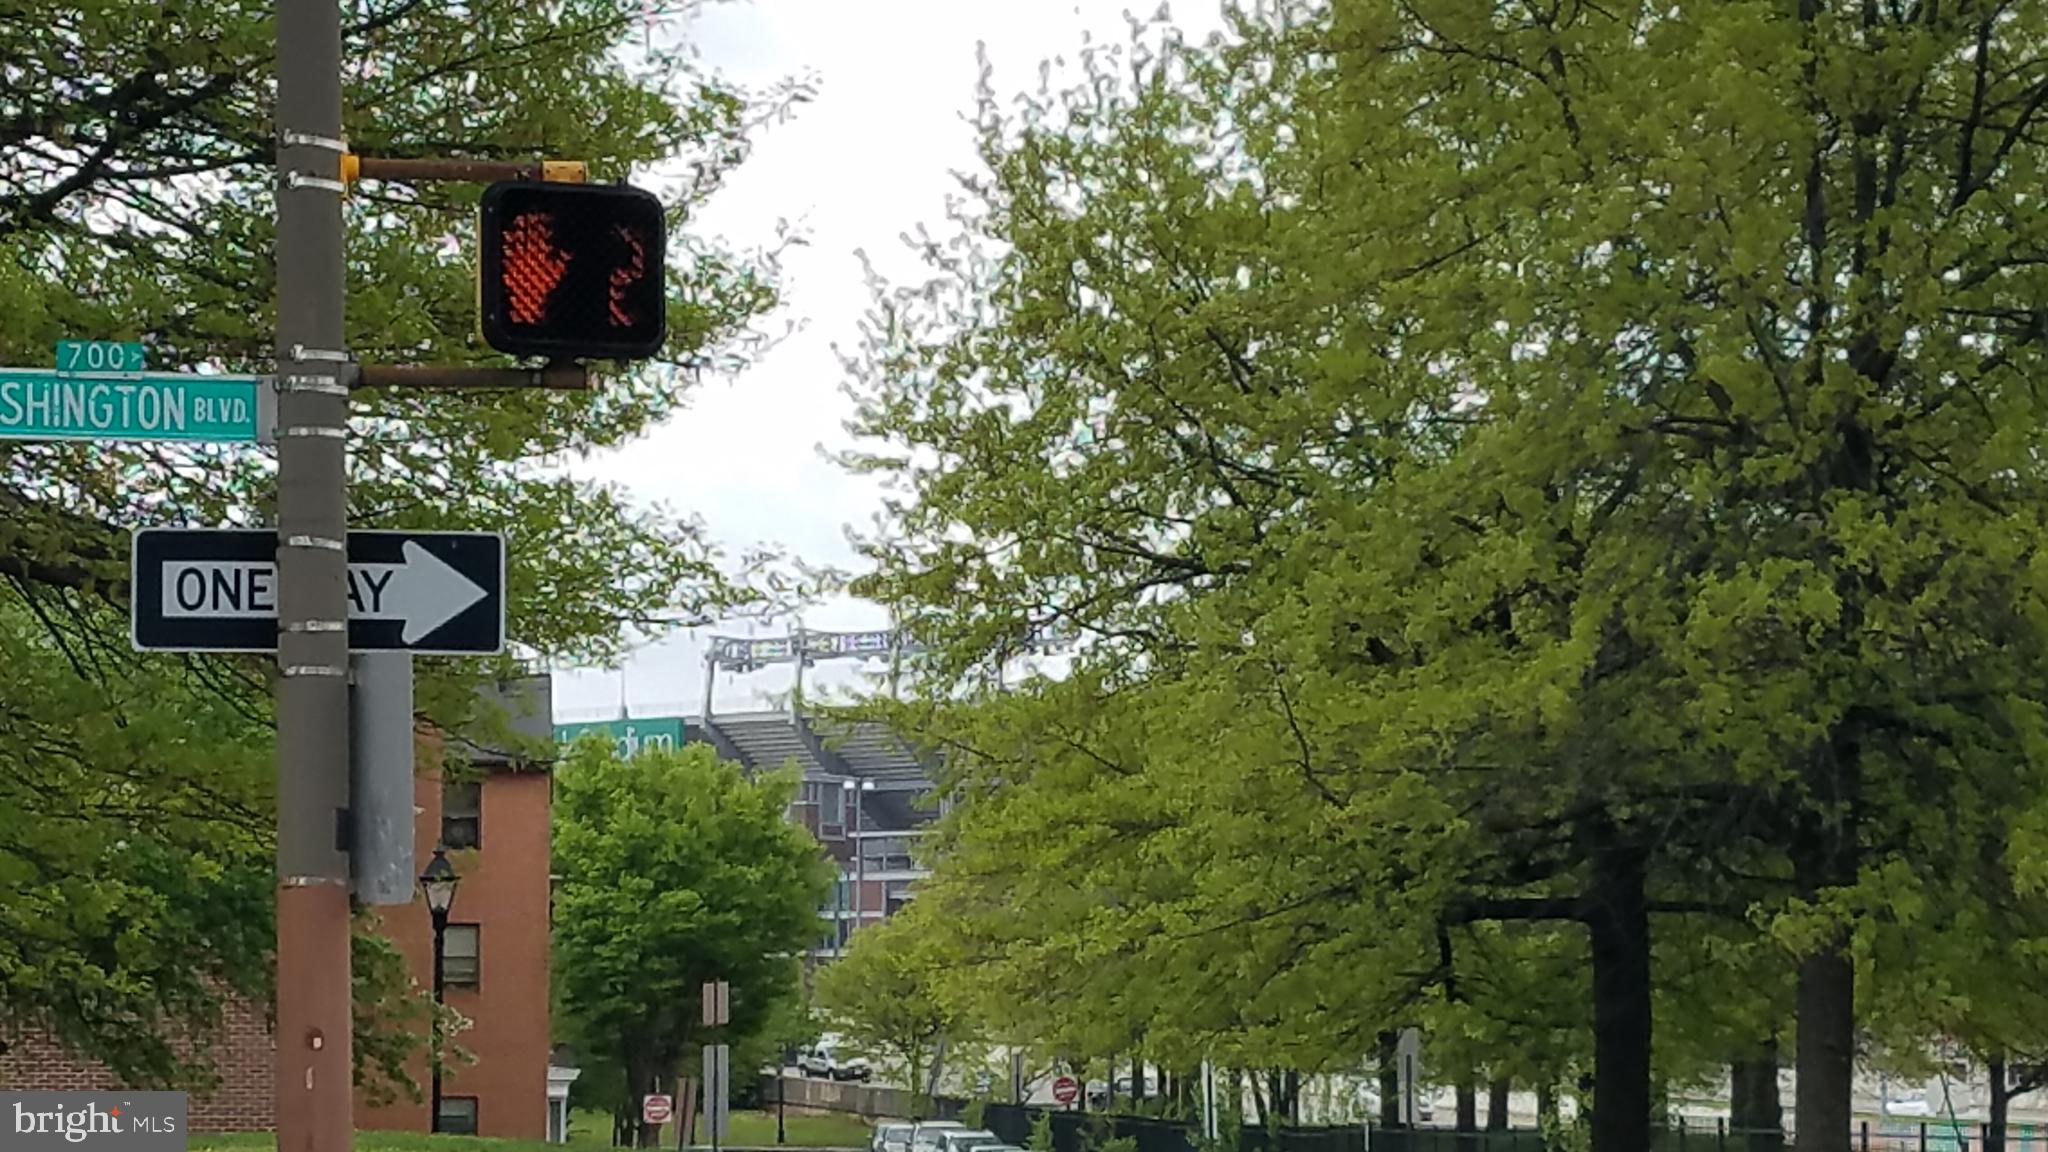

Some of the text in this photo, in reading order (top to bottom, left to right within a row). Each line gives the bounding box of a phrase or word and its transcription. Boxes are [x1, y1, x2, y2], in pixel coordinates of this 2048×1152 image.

[67, 342, 124, 370] 700
[194, 397, 250, 424] BLVD.
[176, 566, 394, 613] ONE AY
